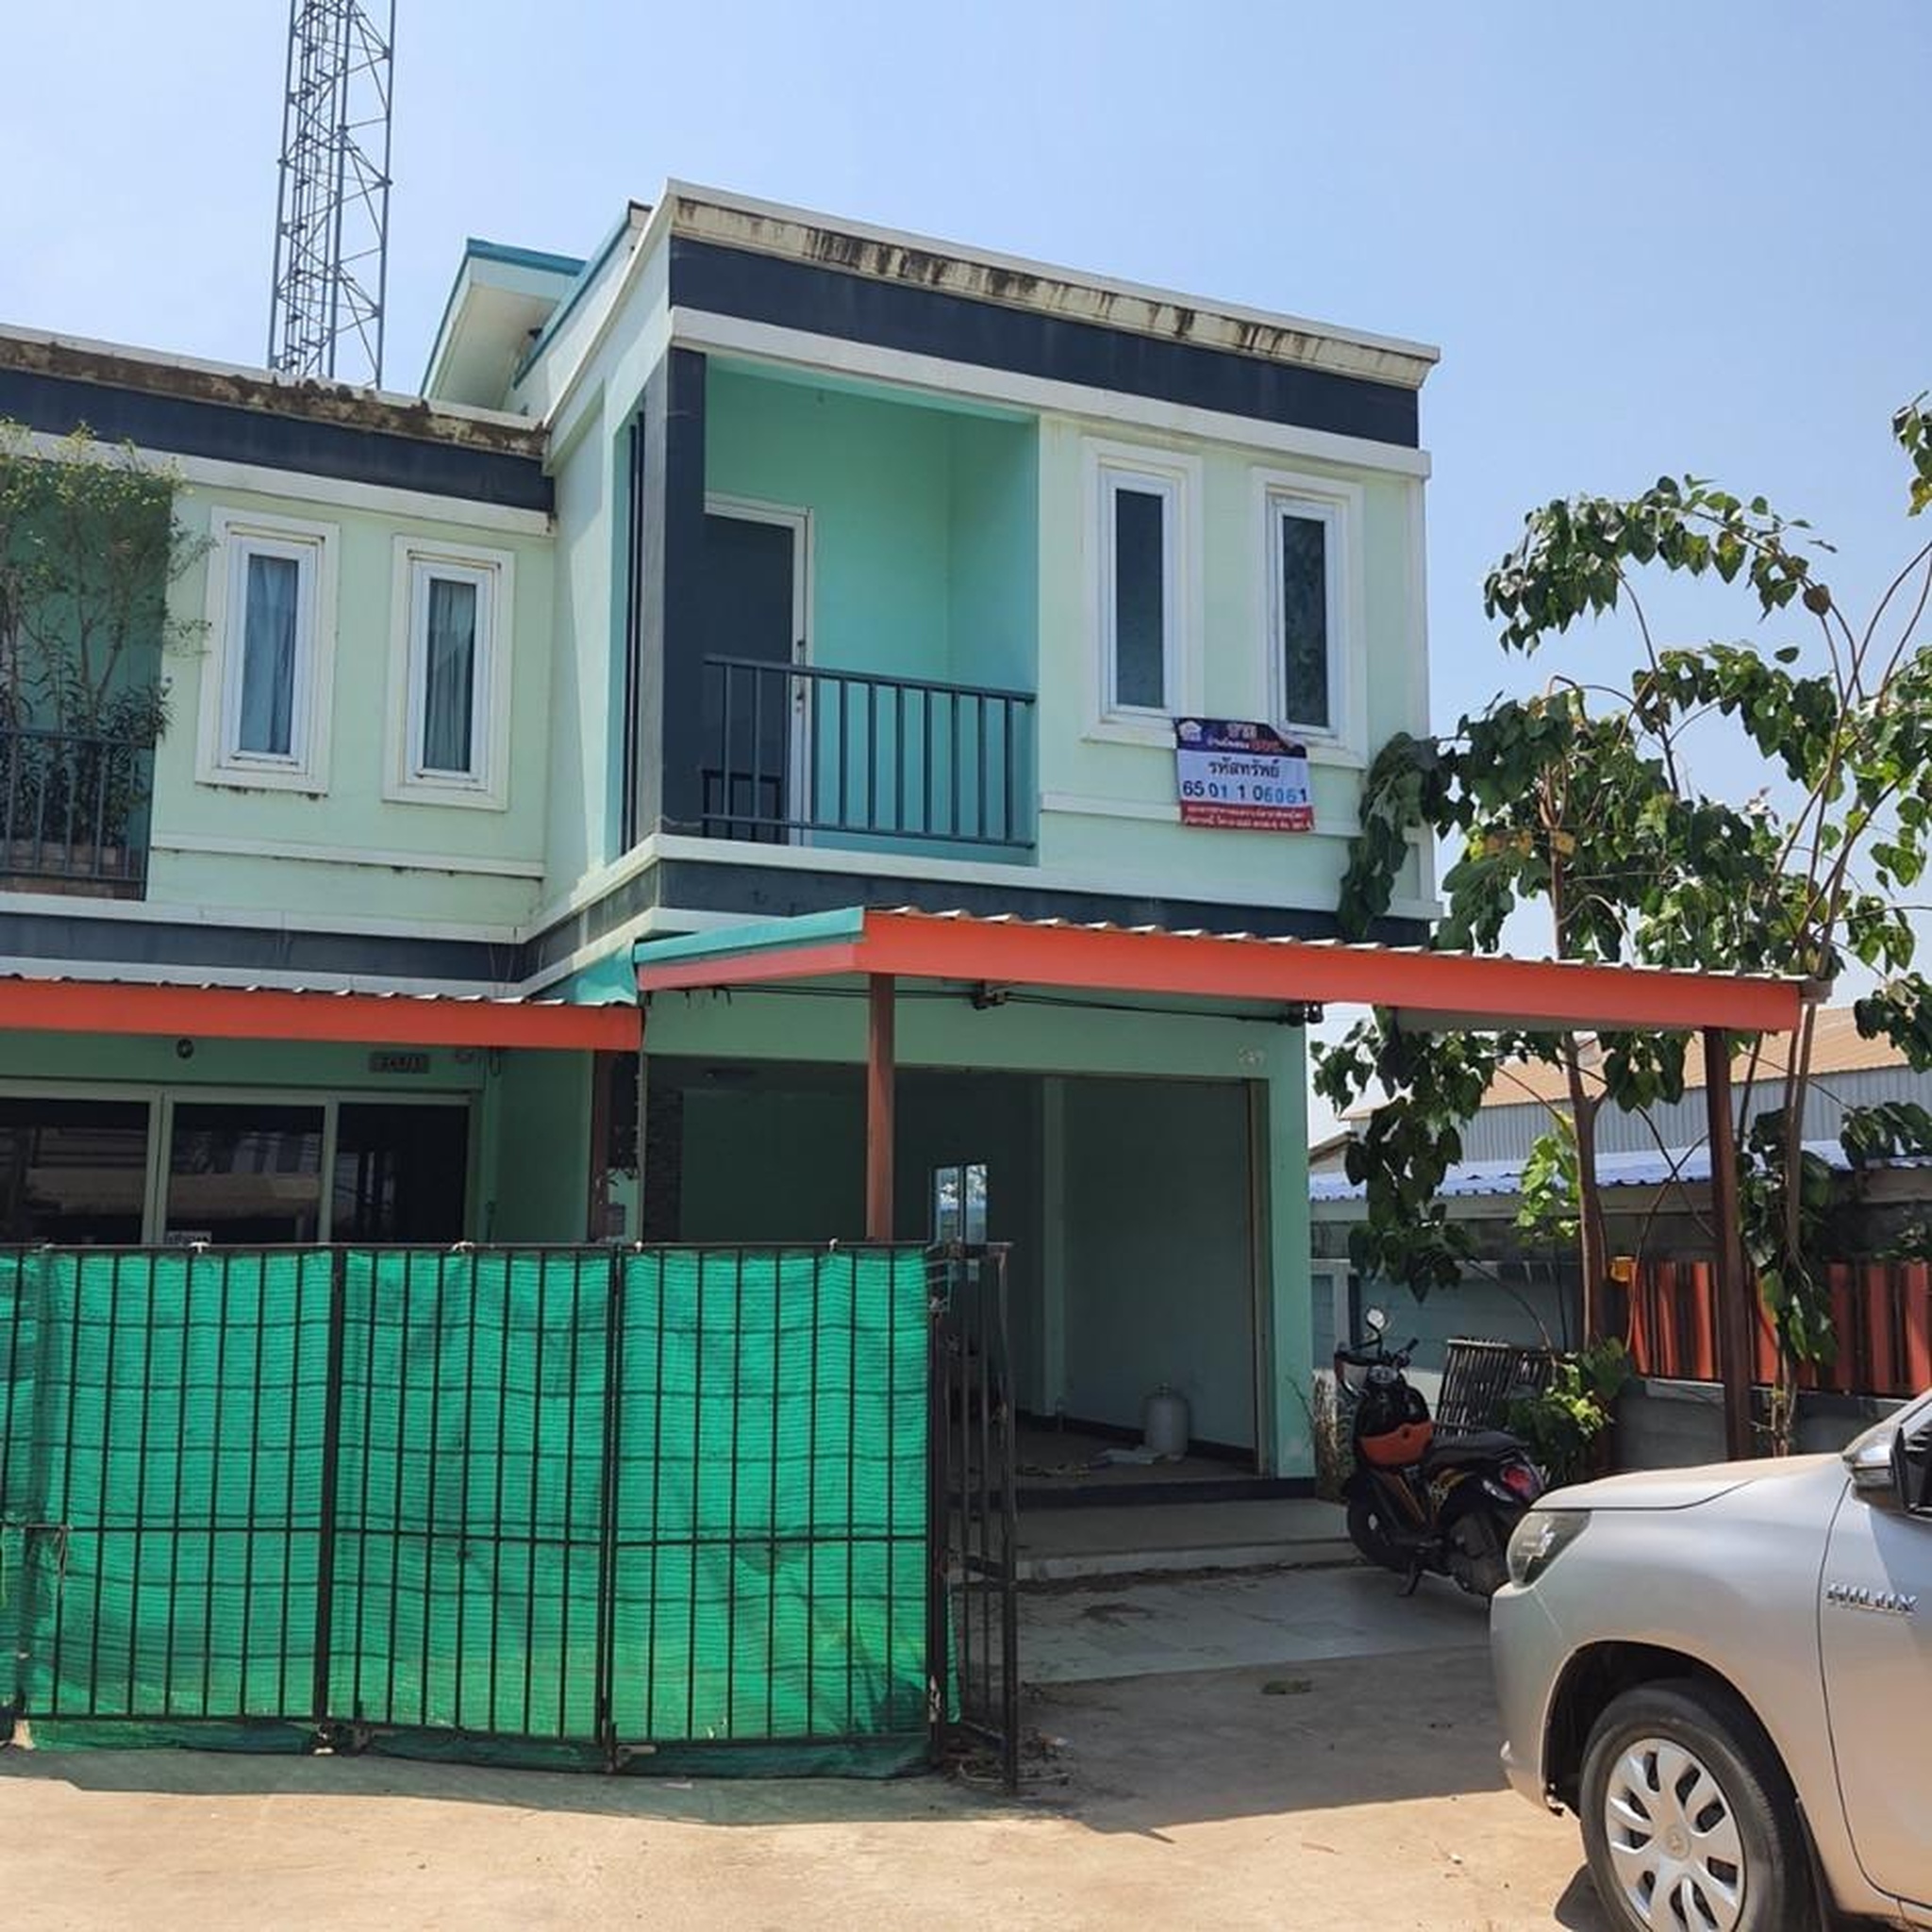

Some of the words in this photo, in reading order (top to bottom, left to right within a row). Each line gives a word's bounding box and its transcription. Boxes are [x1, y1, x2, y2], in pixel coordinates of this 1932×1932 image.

[1208, 757, 1280, 778] รหัสทรัพย์
[1827, 1583, 1919, 1615] HILUX
